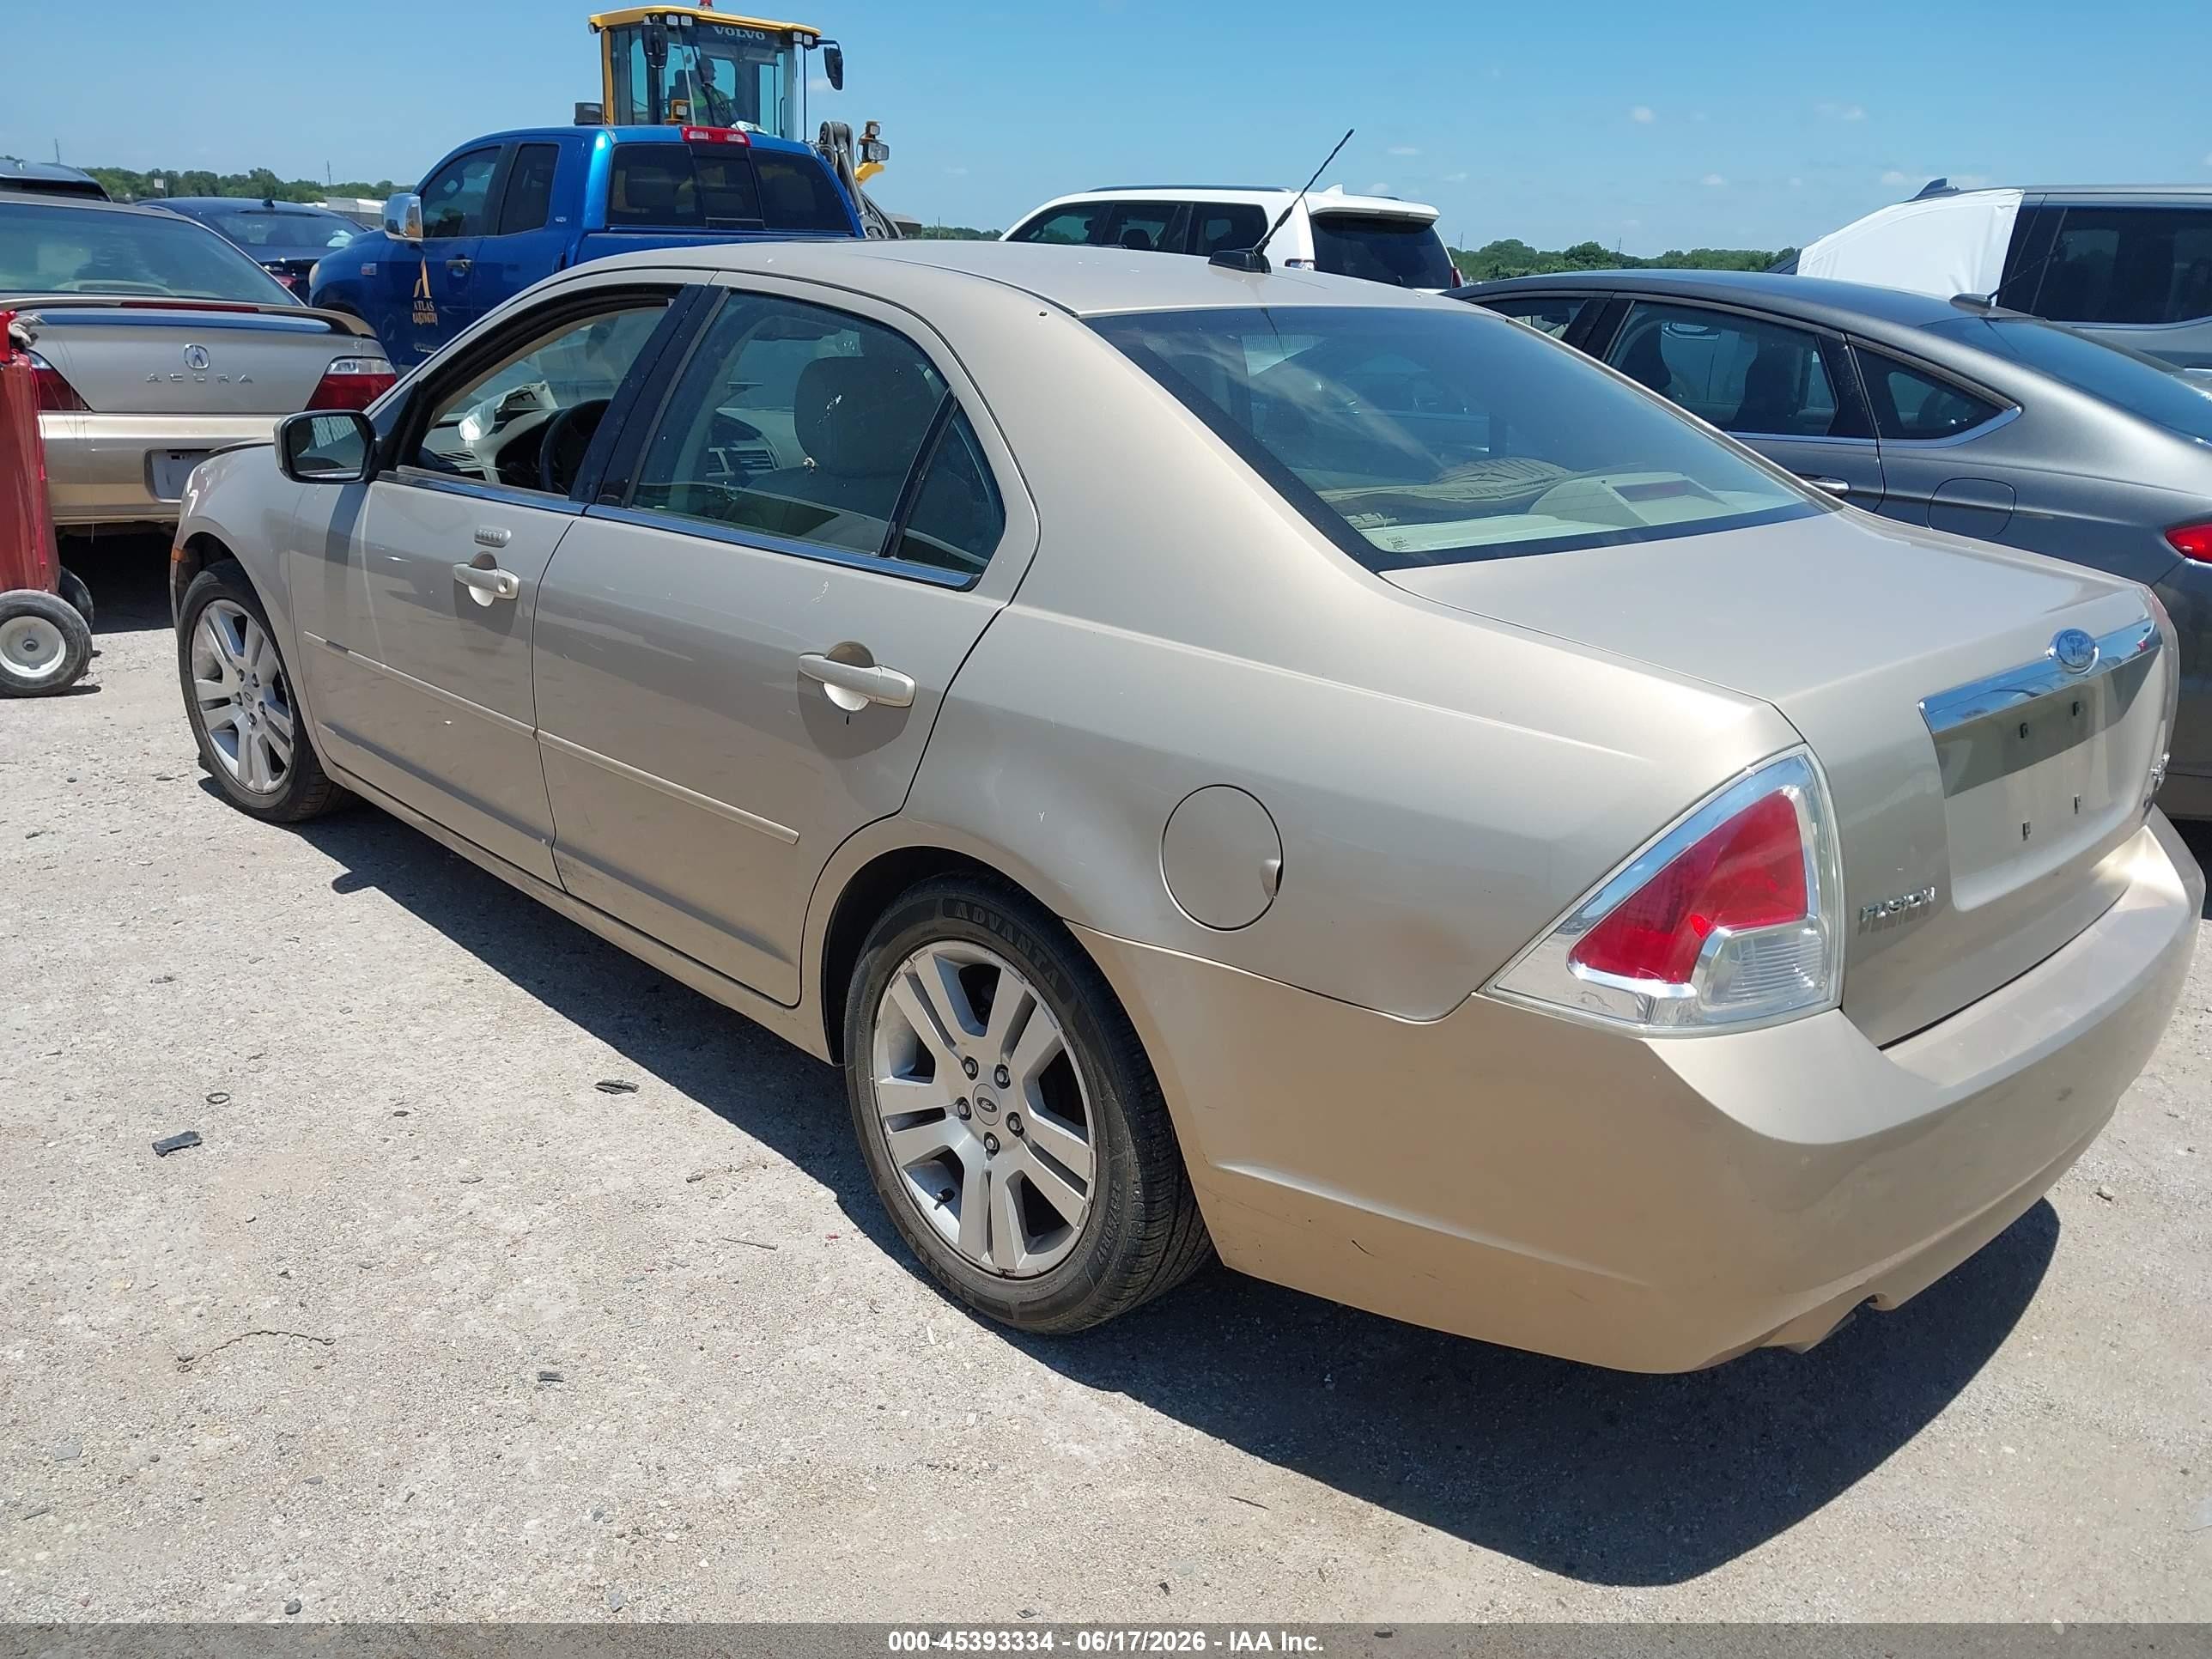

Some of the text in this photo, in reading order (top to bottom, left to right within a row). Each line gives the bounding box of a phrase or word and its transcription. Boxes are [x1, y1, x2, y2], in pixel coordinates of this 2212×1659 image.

[713, 25, 766, 40] VOLVO
[413, 300, 434, 312] ATLAS
[145, 372, 254, 384] ACURA
[1861, 886, 1936, 923] FUSION
[954, 901, 1060, 988] ADVANTA
